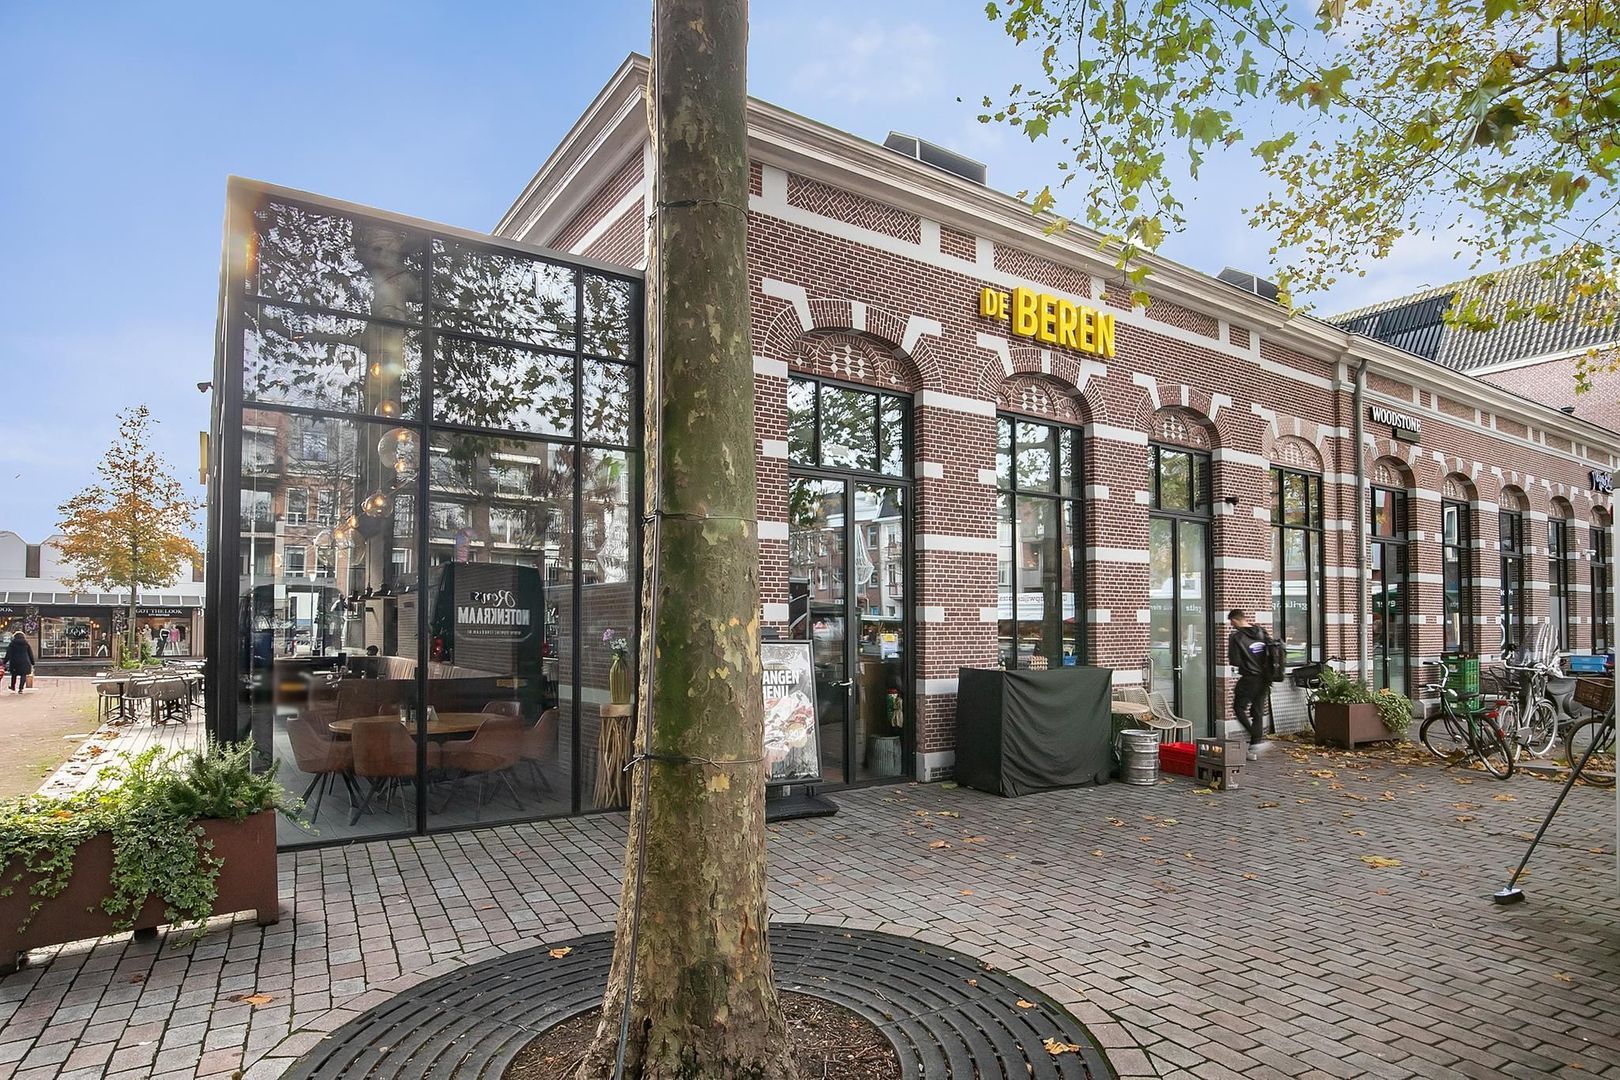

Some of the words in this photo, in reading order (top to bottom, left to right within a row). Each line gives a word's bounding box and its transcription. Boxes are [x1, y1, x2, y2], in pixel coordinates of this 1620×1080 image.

[980, 287, 1010, 320] DE
[1012, 286, 1116, 359] BEREN
[1371, 406, 1422, 433] WOODSTONE
